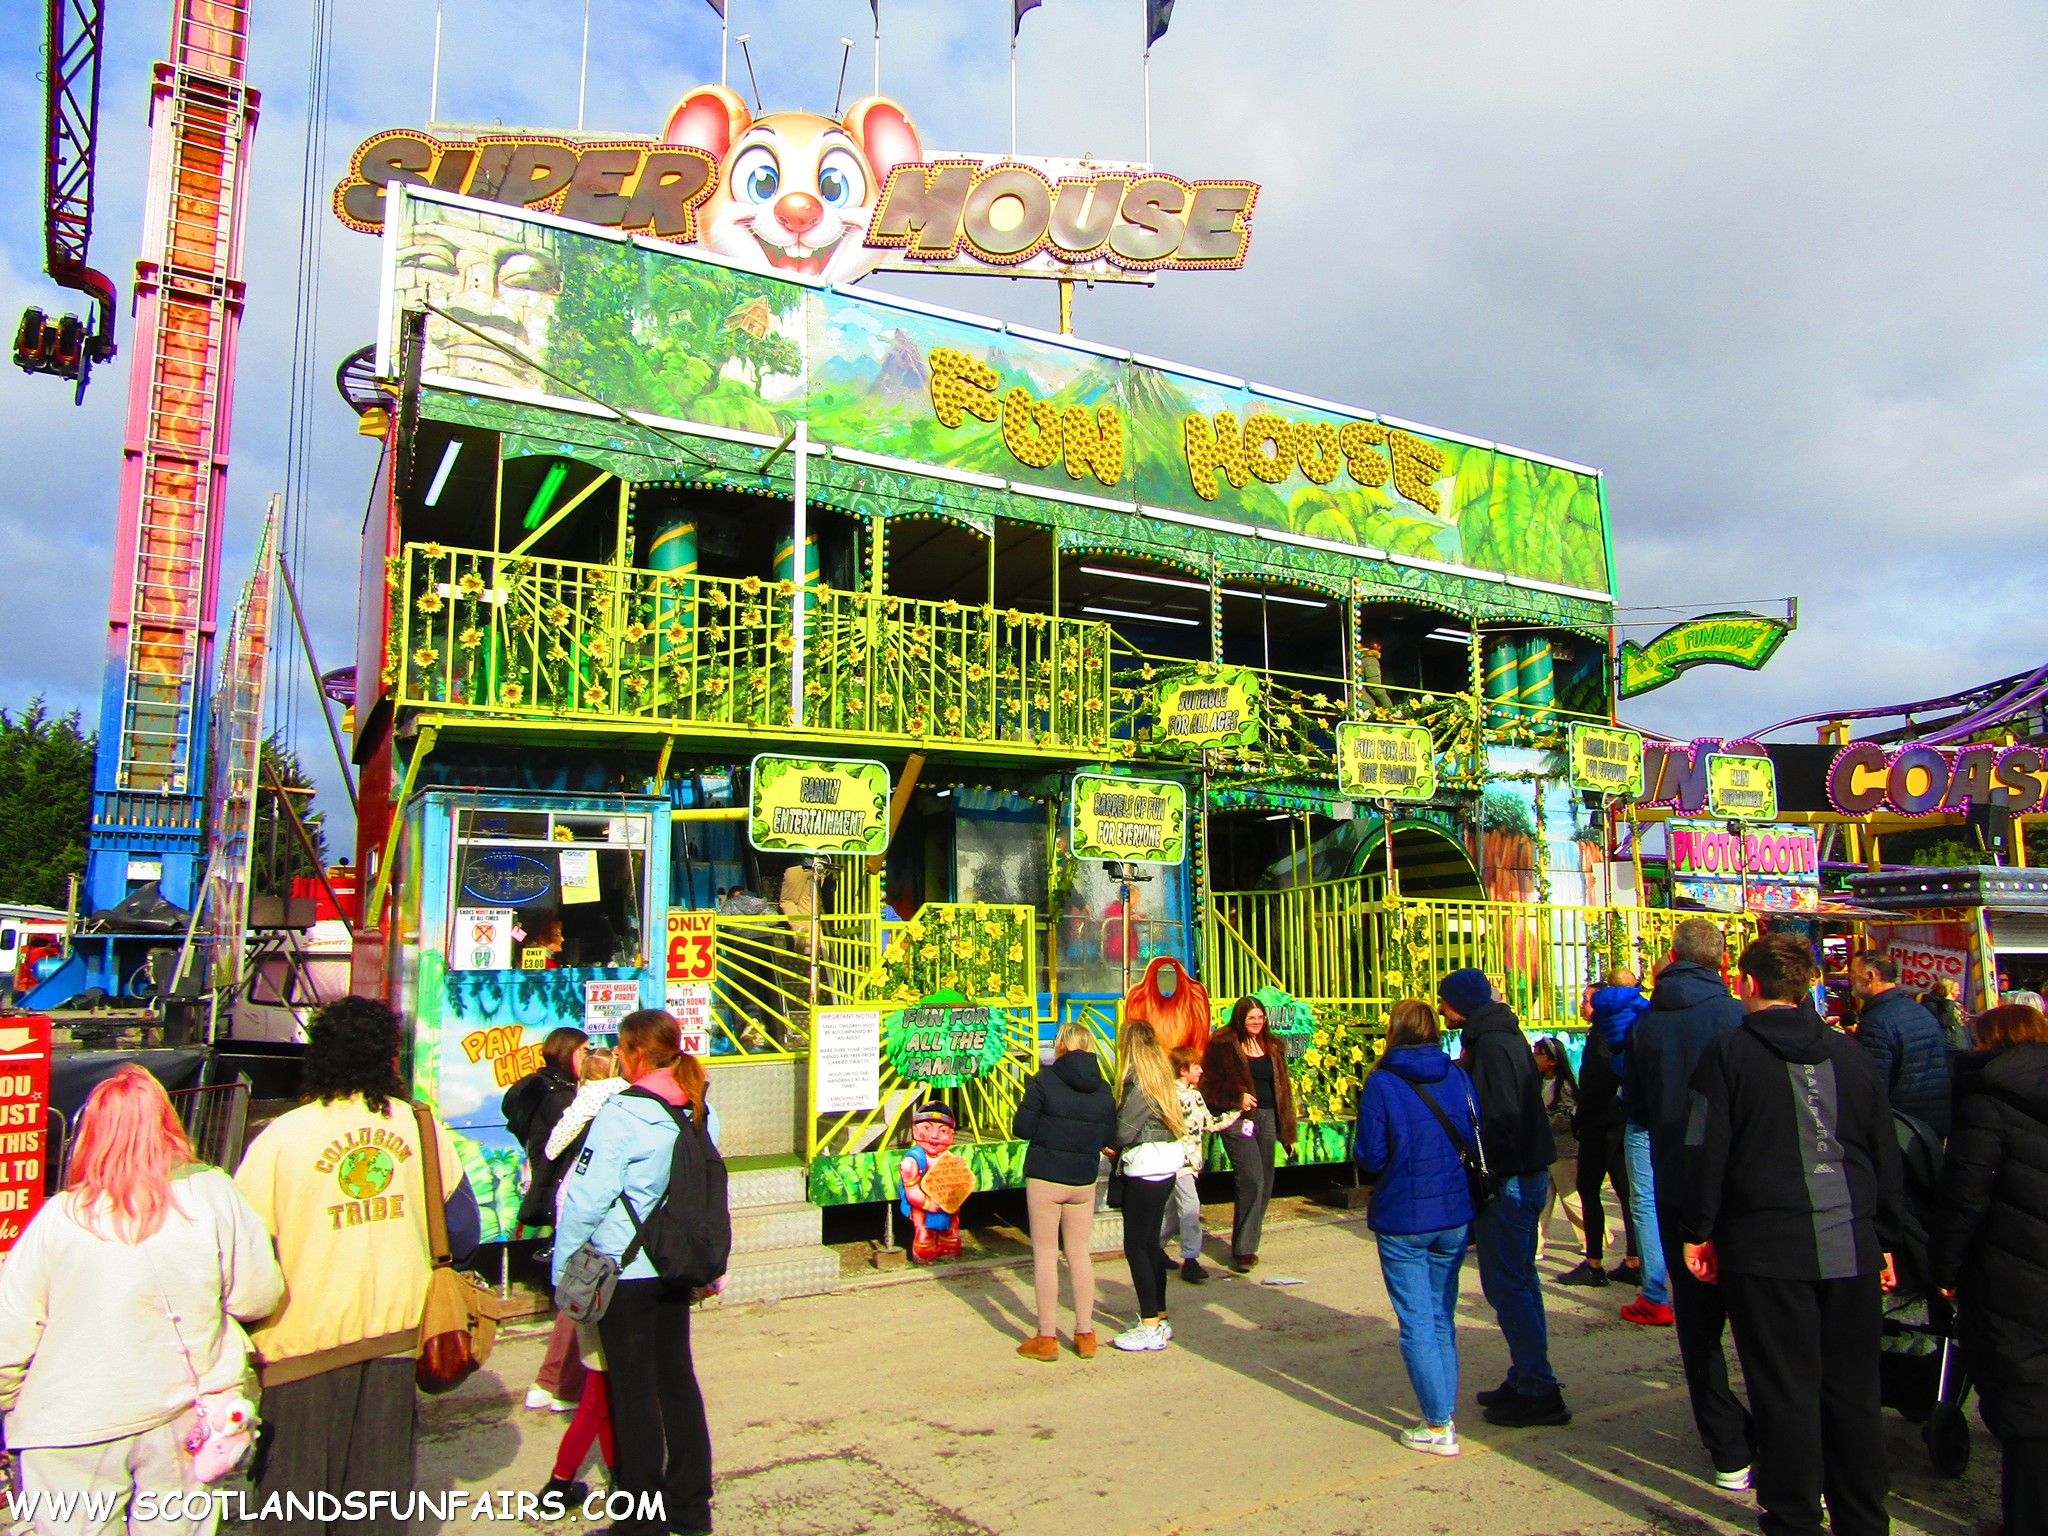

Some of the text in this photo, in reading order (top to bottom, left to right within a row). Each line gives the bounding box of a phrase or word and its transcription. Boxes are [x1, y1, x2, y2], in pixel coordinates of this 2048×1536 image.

[340, 134, 1252, 263] SUPER MOUSE
[929, 346, 1445, 514] FUN HOUSE
[1634, 624, 1763, 674] IT'S THE FUNHOUSE
[1178, 687, 1229, 711] SUITABLE
[1168, 710, 1239, 736] FOR ALL AGES
[1354, 738, 1417, 762] FUN FOR ALL
[1358, 762, 1417, 785] THE FAMILY
[1827, 741, 2048, 817] COAS
[800, 777, 841, 804] FAMILY
[1094, 792, 1166, 821] BARRELS OF FUN
[773, 807, 865, 836] ENTERTAINMENT
[1097, 820, 1161, 848] FOR EVERYONE
[467, 867, 502, 890] Pay
[668, 916, 712, 931] ONLY
[524, 960, 544, 969] £3.00
[667, 935, 713, 978] £3
[1890, 946, 1963, 975] PHOTO
[588, 990, 613, 1002] 18
[670, 997, 706, 1006] ONCE ROUND
[682, 988, 693, 996] IT'S
[677, 1007, 699, 1016] SO TAKE
[677, 1017, 704, 1026] OUR TIME
[902, 1006, 990, 1028] FUN FOR
[461, 1025, 523, 1064] PAY
[906, 1030, 987, 1052] ALL THE
[494, 1042, 547, 1088] HER
[907, 1055, 983, 1077] FAMILY
[0, 1075, 32, 1097] OU
[0, 1103, 41, 1126] UST
[313, 1127, 413, 1174] COLLUSION
[14, 1158, 39, 1181] TO
[327, 1194, 404, 1230] TRIBE
